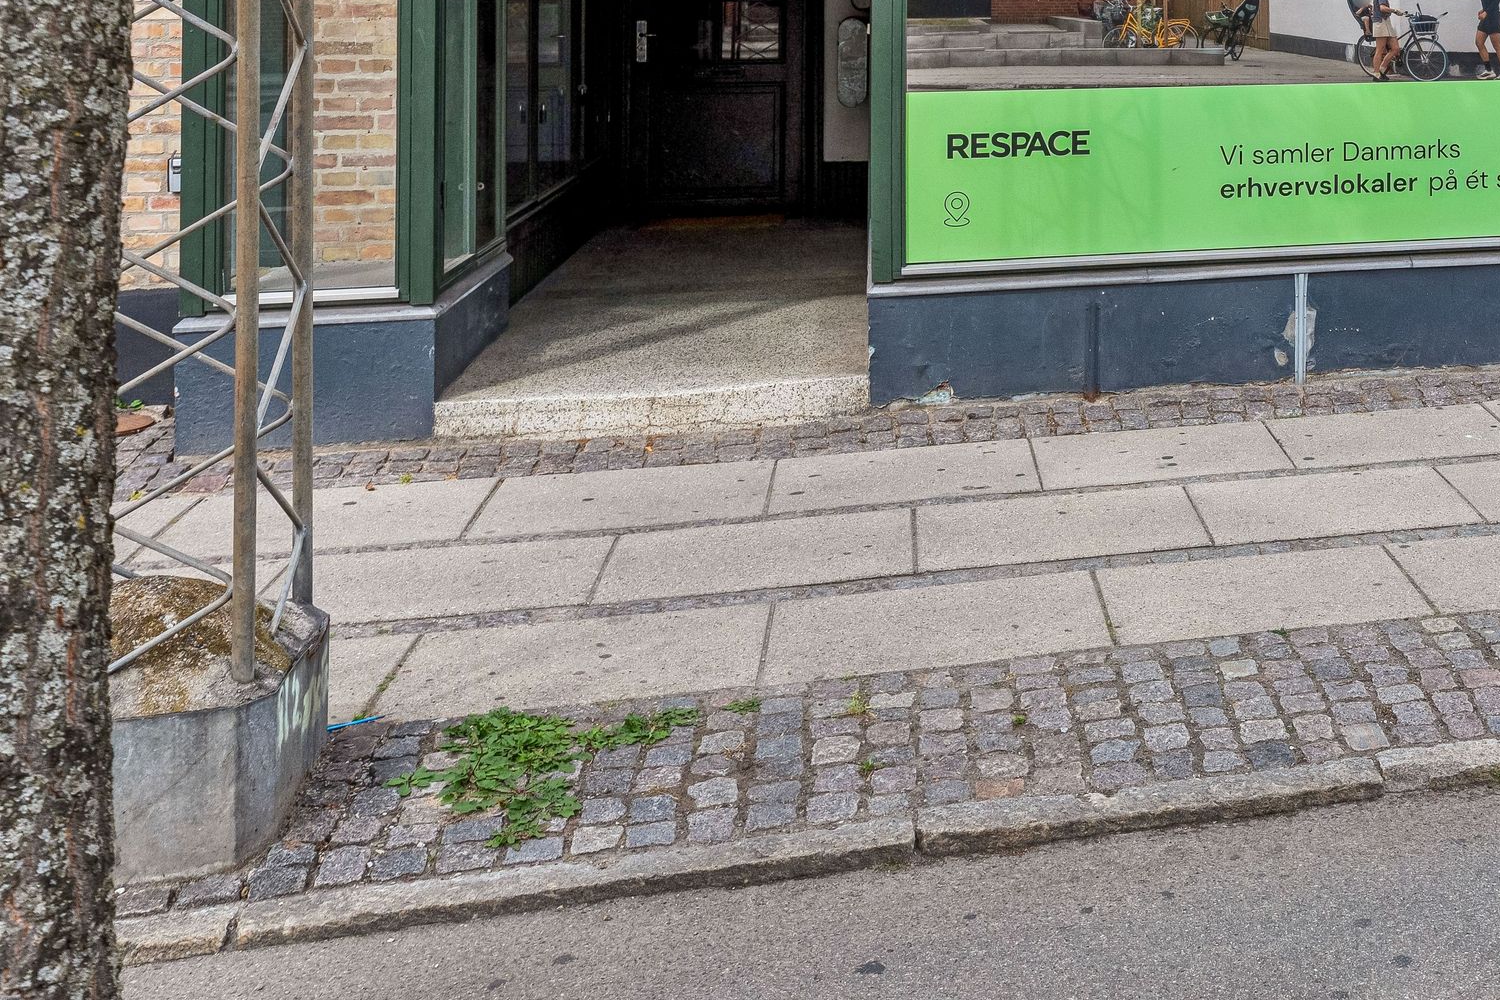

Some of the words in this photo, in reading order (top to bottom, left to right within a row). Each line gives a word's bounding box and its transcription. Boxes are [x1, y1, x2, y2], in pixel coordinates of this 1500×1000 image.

[946, 130, 1091, 160] RESPACE
[1219, 144, 1243, 166] Vi
[1252, 141, 1335, 165] samler
[1343, 138, 1461, 162] Danmarks
[1220, 173, 1418, 199] erhvervslokaler
[1429, 169, 1458, 197] på
[1465, 170, 1489, 190] ét
